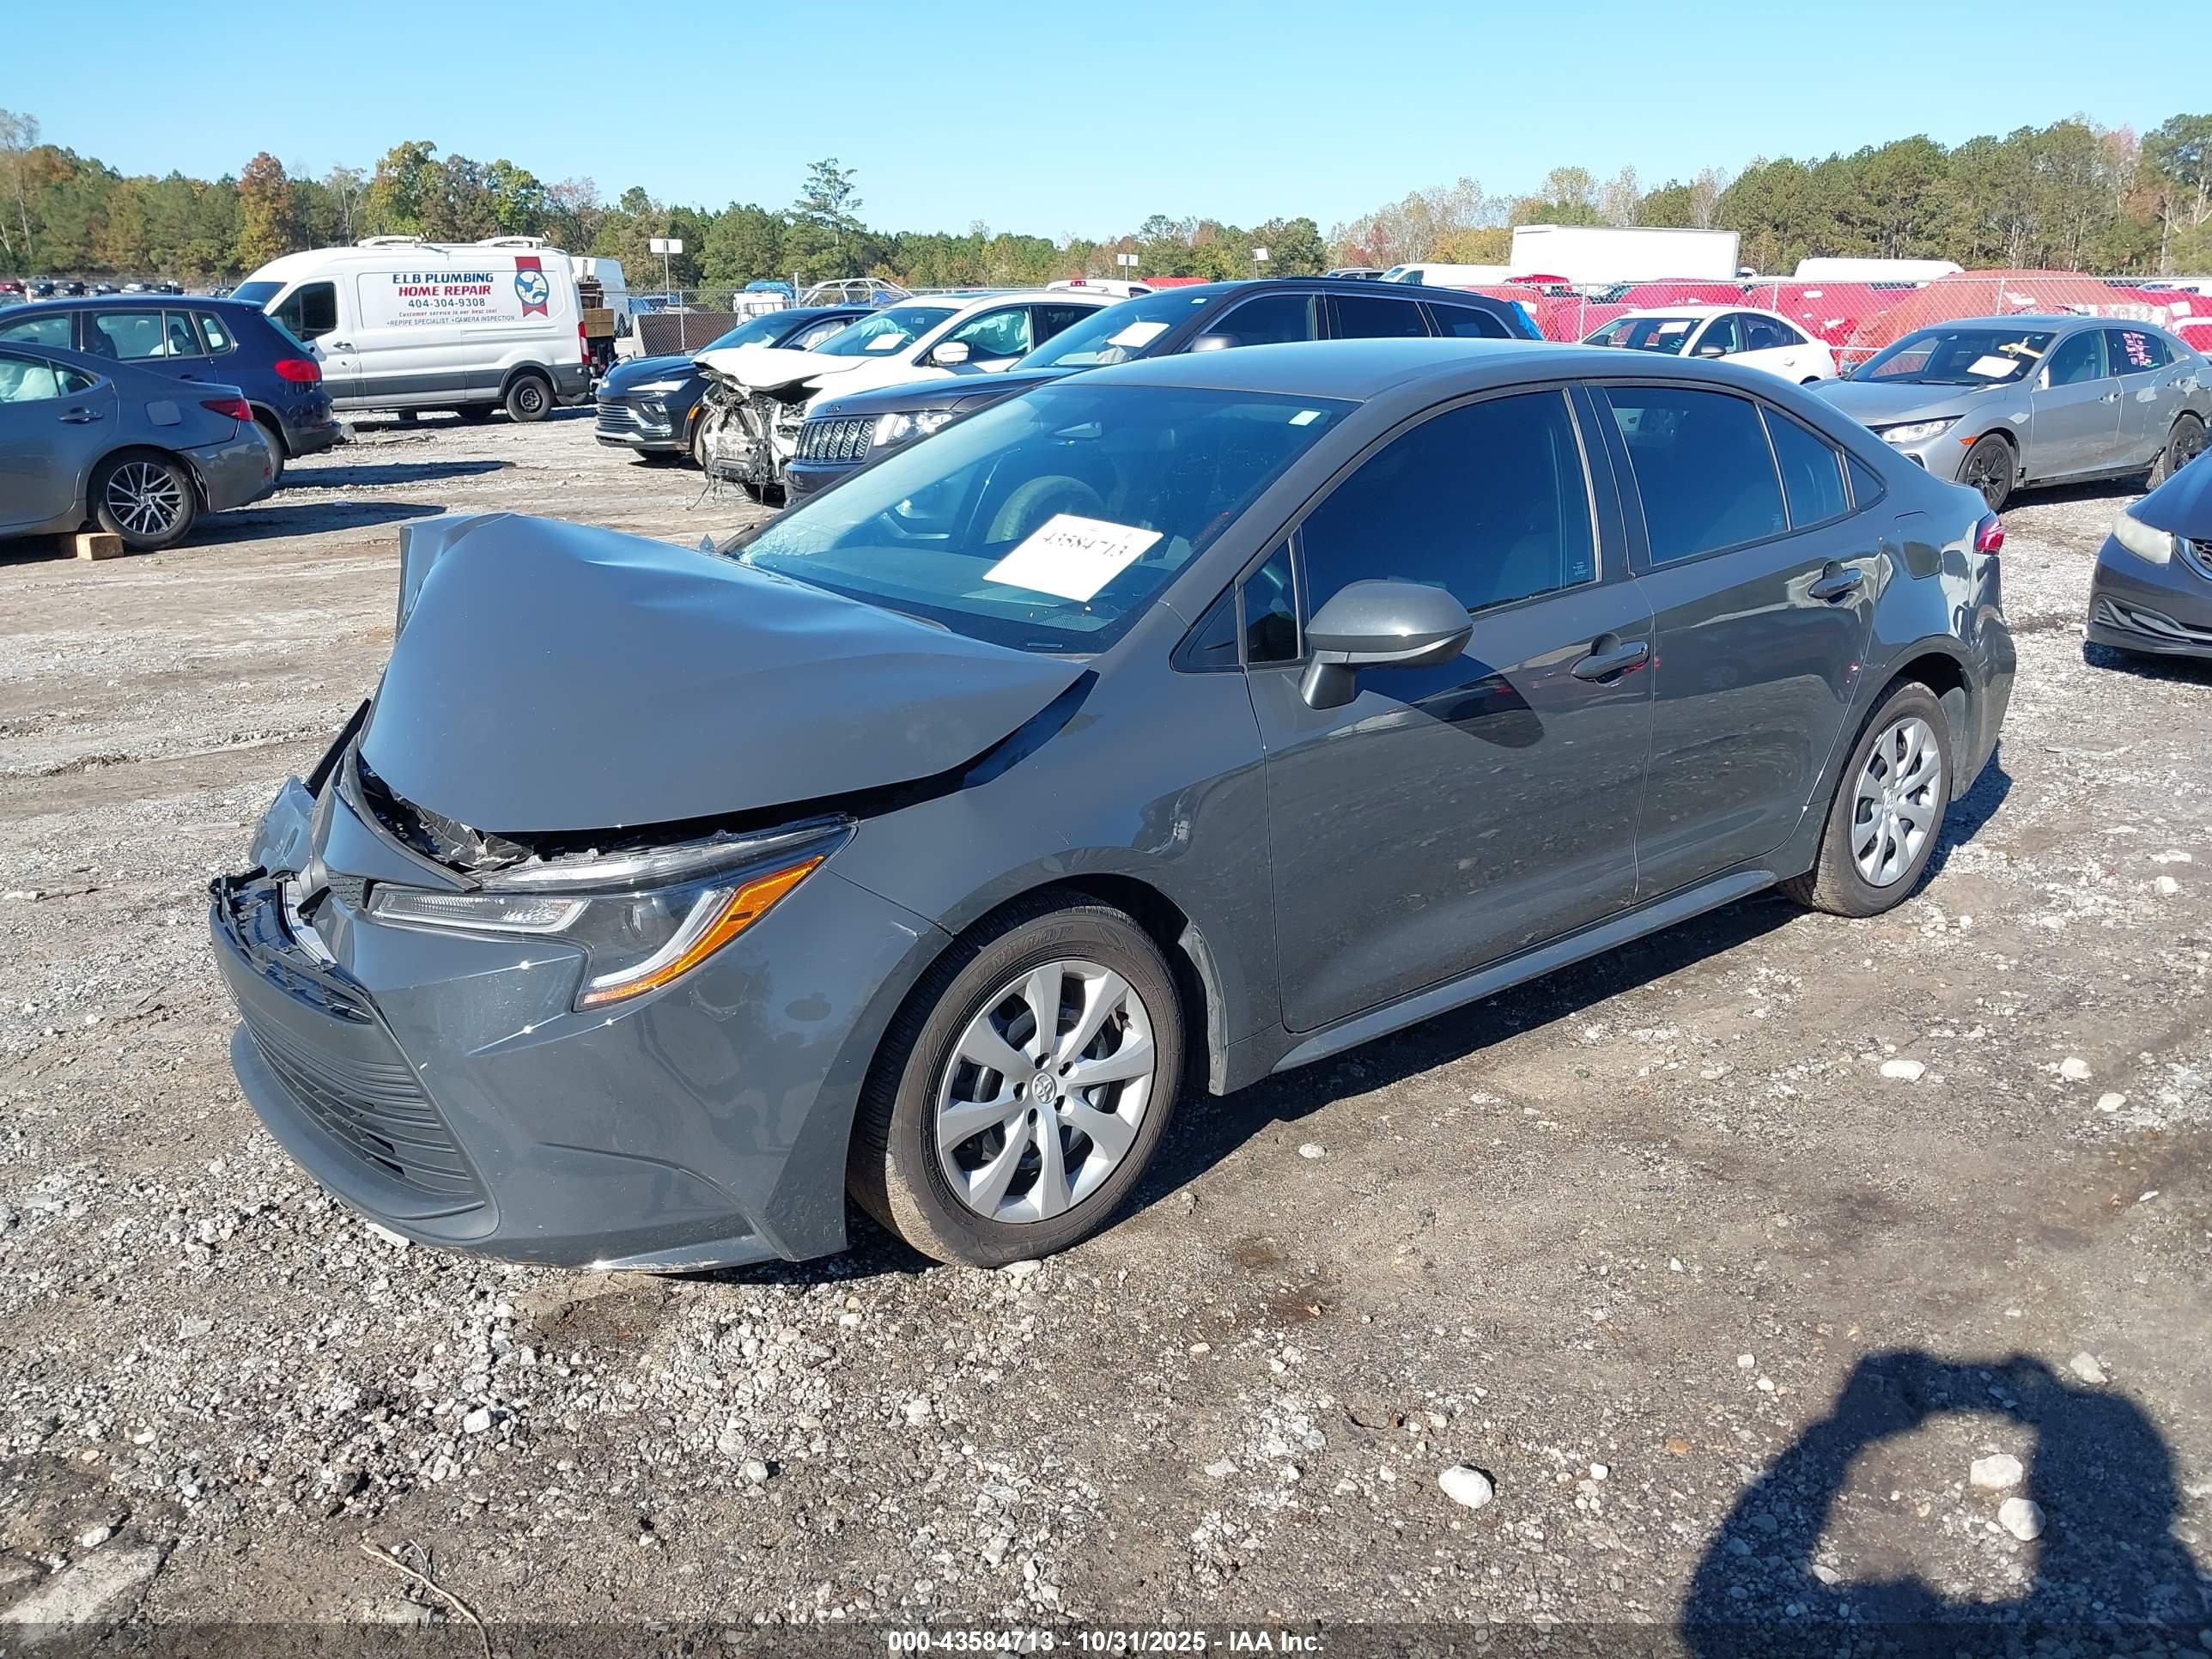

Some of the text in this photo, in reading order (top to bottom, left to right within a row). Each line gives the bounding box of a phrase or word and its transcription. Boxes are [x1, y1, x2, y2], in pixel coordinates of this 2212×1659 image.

[425, 272, 494, 283] PLUMBING
[398, 285, 492, 297] HOME REPAIR
[408, 298, 486, 308] 404-304-9308
